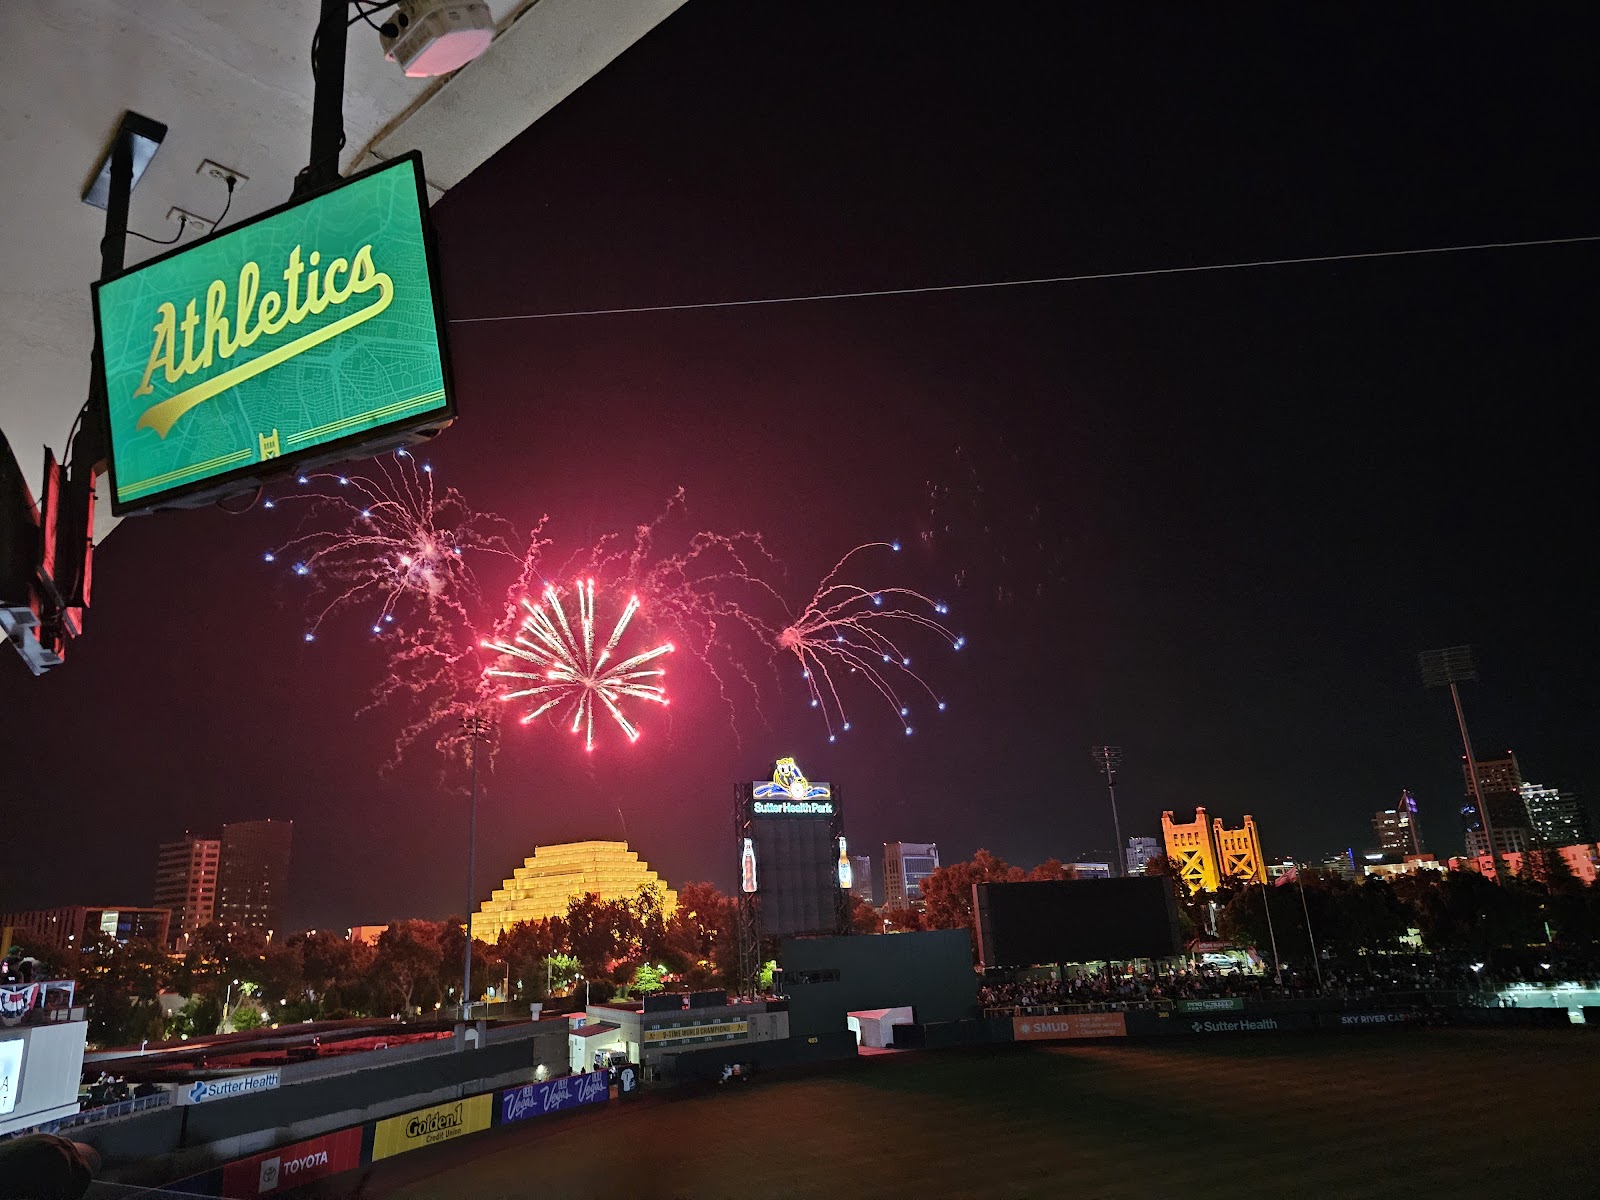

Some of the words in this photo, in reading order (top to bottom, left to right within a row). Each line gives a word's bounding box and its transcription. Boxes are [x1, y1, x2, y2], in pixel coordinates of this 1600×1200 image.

[132, 244, 393, 400] Athletics
[754, 802, 782, 813] Sutter
[783, 802, 811, 813] Health
[811, 802, 832, 813] Park
[1204, 1021, 1239, 1032] Sutter
[1240, 1018, 1278, 1030] Health
[1341, 1016, 1358, 1024] SKY
[1361, 1015, 1386, 1023] RIVER
[1033, 1022, 1069, 1033] SMUD
[208, 1081, 243, 1096] Sutter
[244, 1073, 278, 1089] Health
[504, 1090, 538, 1119] Vegas
[540, 1082, 572, 1111] Vegas
[574, 1076, 606, 1102] Vegas
[426, 1133, 444, 1143] Credit
[446, 1128, 462, 1138] Union
[284, 1151, 328, 1175] TOYOTA
